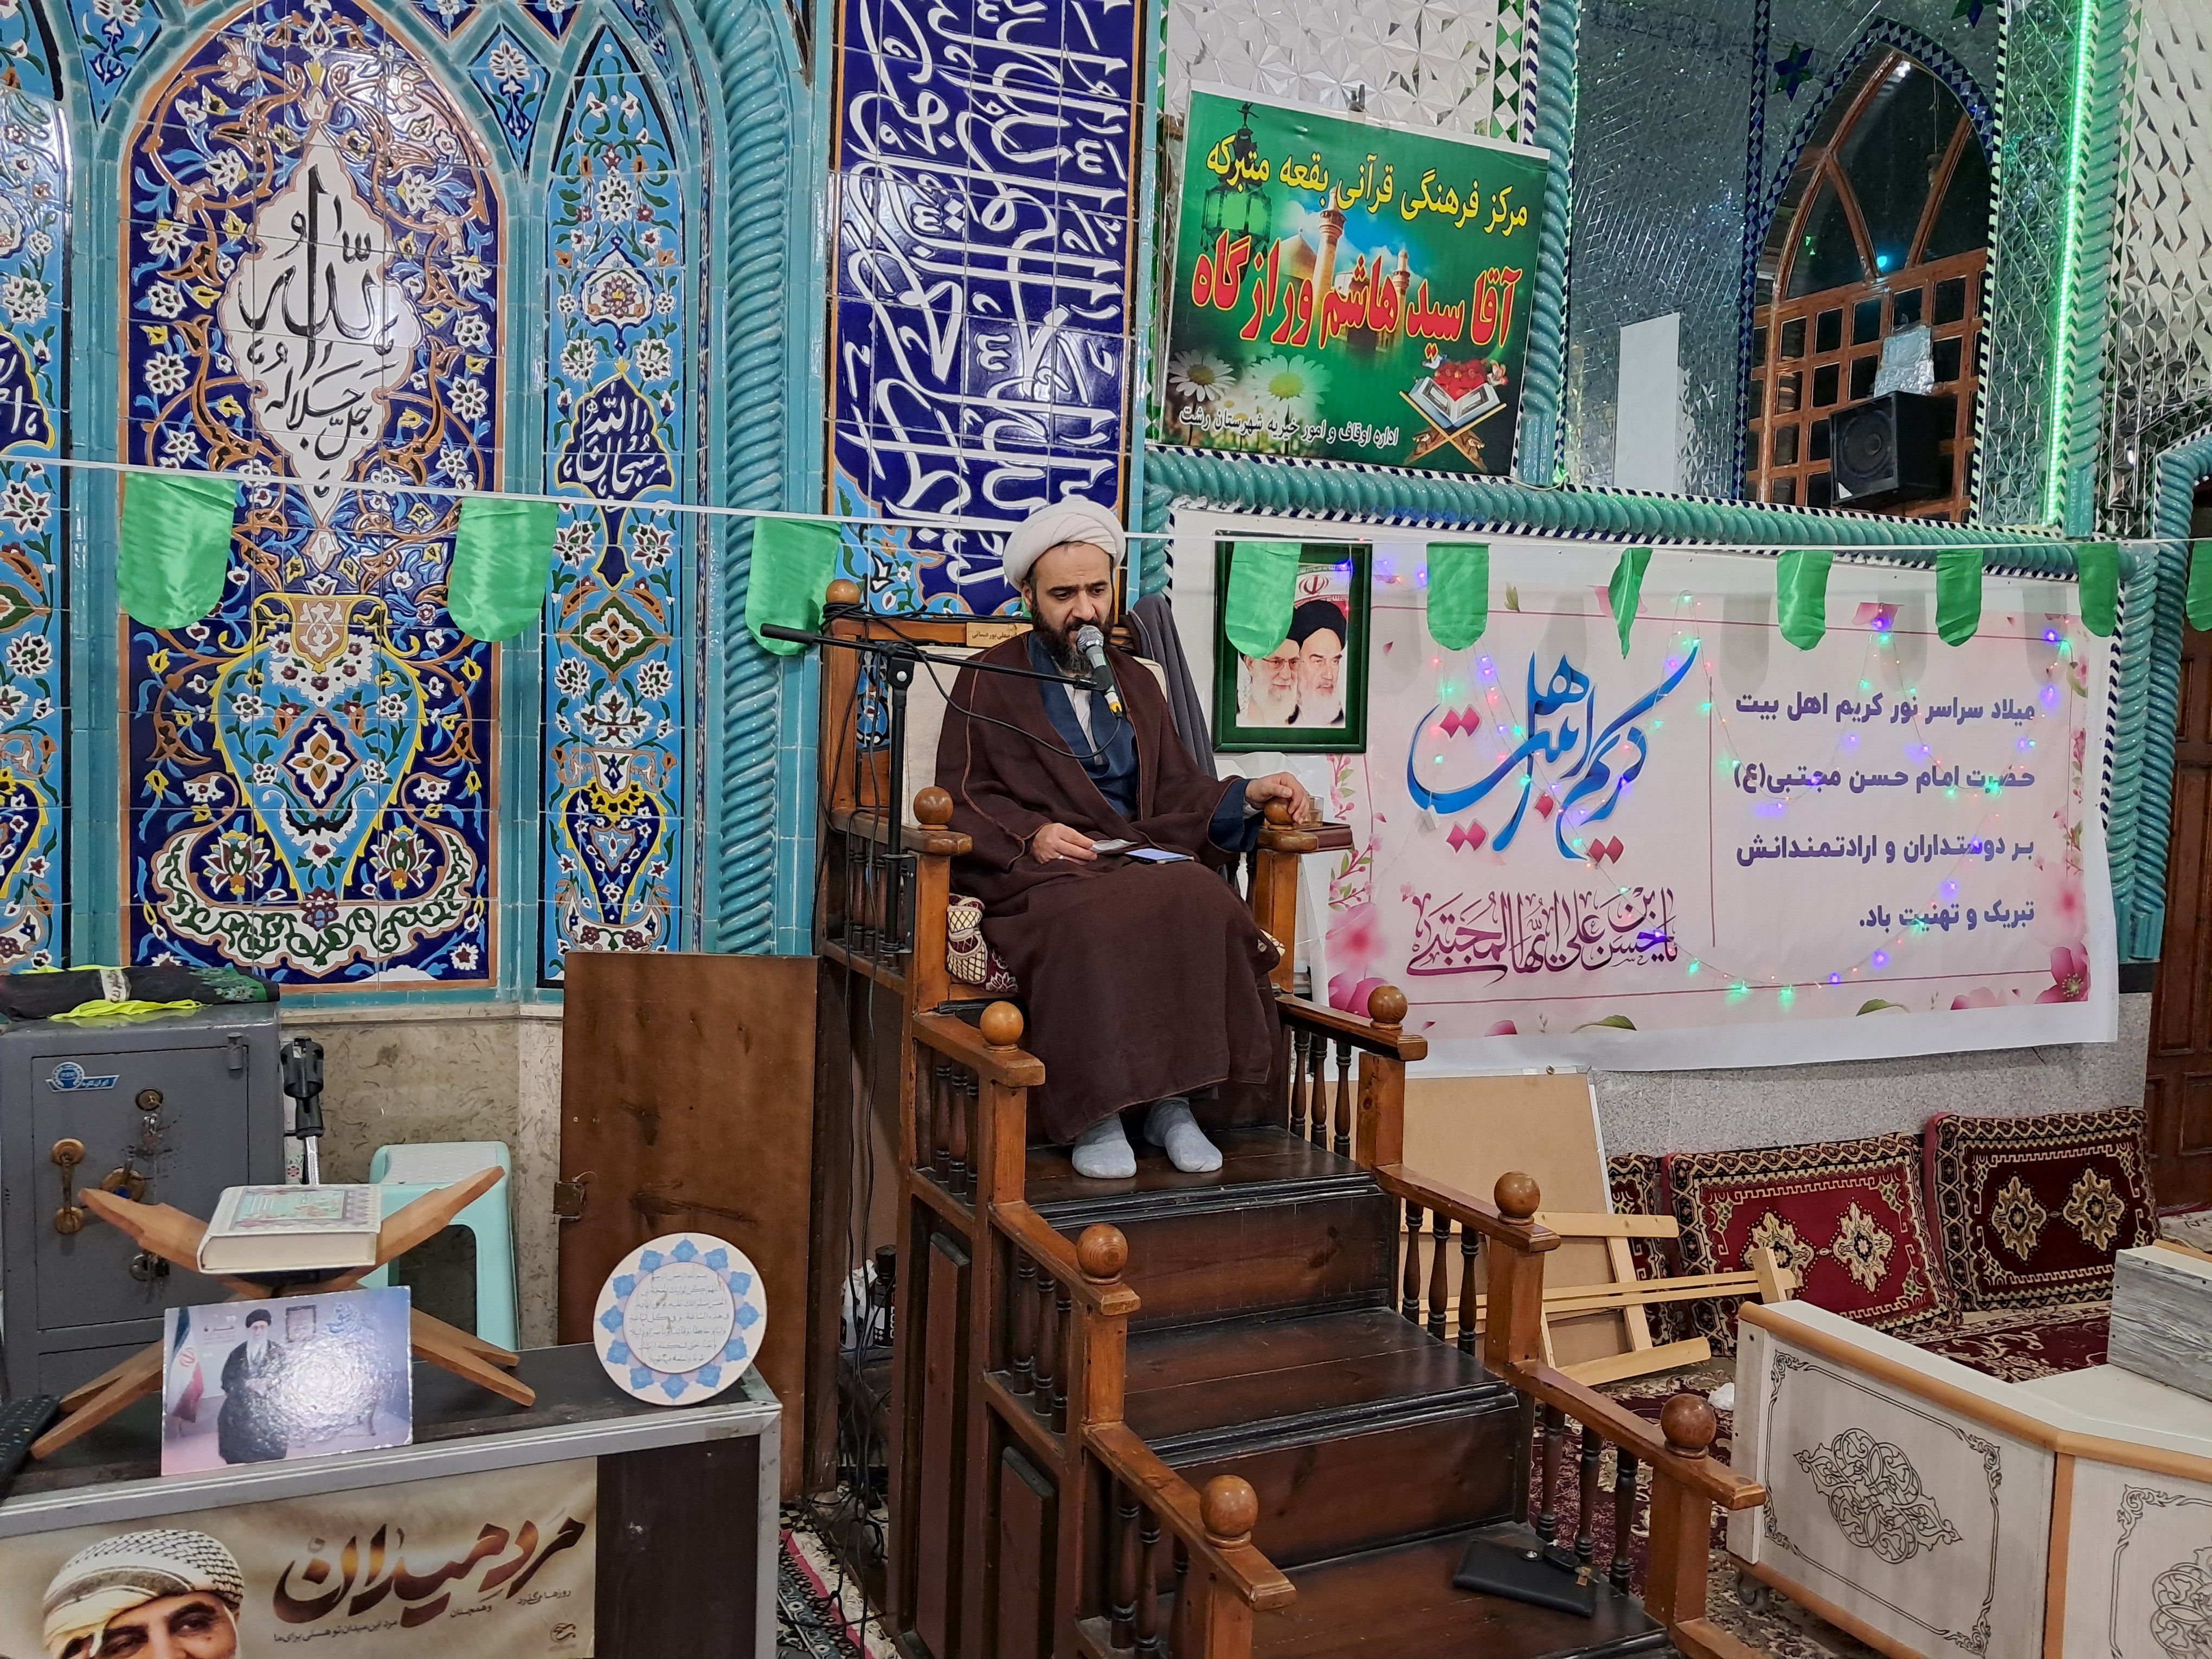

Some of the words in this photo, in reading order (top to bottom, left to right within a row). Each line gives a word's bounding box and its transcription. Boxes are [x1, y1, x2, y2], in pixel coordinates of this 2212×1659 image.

[1206, 133, 1270, 194] متبرکه
[1279, 151, 1329, 208] بقعه
[1336, 153, 1394, 214] قرآنی
[1400, 168, 1480, 229] فرهنگی
[1483, 185, 1528, 237] مرکز
[1320, 253, 1400, 351] هاشم
[1469, 265, 1523, 348] آقا
[1406, 279, 1465, 360] سید
[1179, 406, 1211, 430] رشت
[1213, 409, 1264, 438] شهرستان
[1267, 417, 1300, 441] خیریه
[1301, 420, 1326, 441] امور
[1327, 426, 1337, 442] و
[1338, 421, 1373, 448] اوقاف
[1373, 426, 1399, 448] اداره
[1735, 693, 1779, 721] بیت
[1786, 691, 1828, 722] اهل
[1835, 691, 1884, 723] کریم
[1889, 693, 1918, 724] نور
[1925, 696, 1984, 725] سراسر
[1991, 697, 2035, 726] میلاد
[1848, 770, 1909, 794] حسن
[1916, 764, 1959, 794] امام
[1965, 764, 2035, 794] حضرت
[1736, 833, 1877, 867] ارادتمندانش
[1886, 839, 1896, 863] و
[1903, 833, 2005, 864] دوستداران
[2011, 840, 2034, 861] بر
[1898, 903, 1960, 932] تهنیت
[1966, 908, 1978, 931] و
[1984, 898, 2035, 929] تبریک
[478, 1516, 586, 1600] مرد
[272, 1522, 510, 1629] میدان
